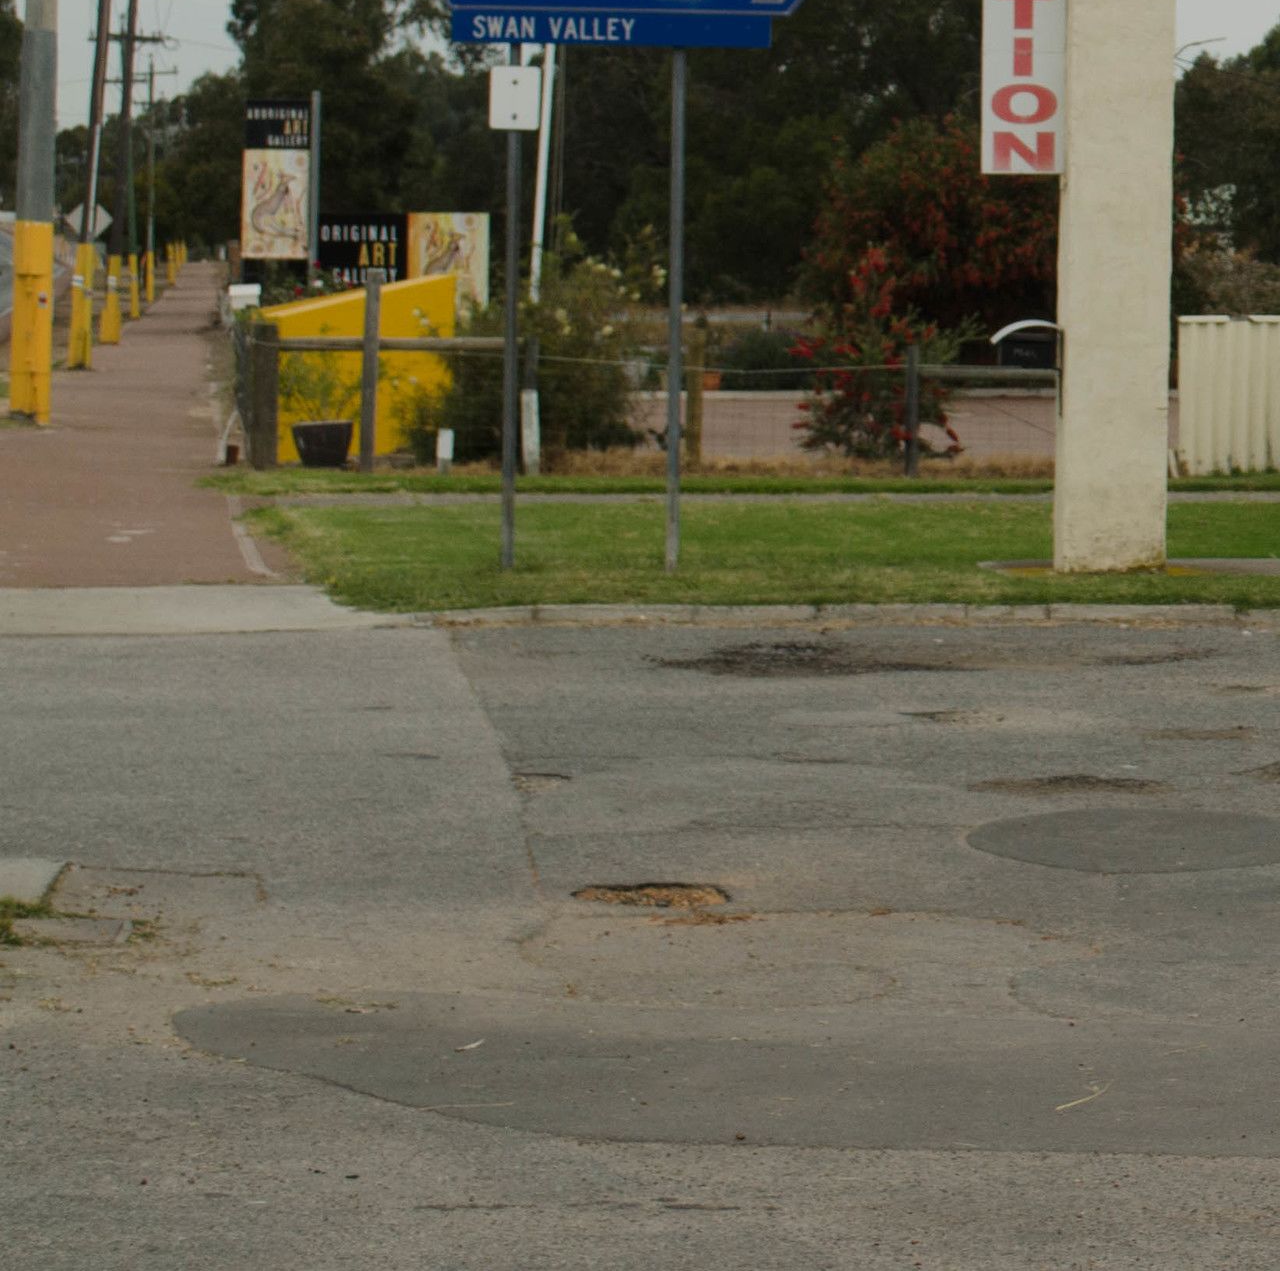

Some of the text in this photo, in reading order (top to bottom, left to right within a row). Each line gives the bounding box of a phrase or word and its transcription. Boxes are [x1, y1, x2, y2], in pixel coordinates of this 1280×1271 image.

[471, 15, 636, 42] SWAN VALLEY
[320, 224, 397, 242] ORIGINAL
[358, 242, 397, 266] ART
[332, 267, 398, 284] GALLY
